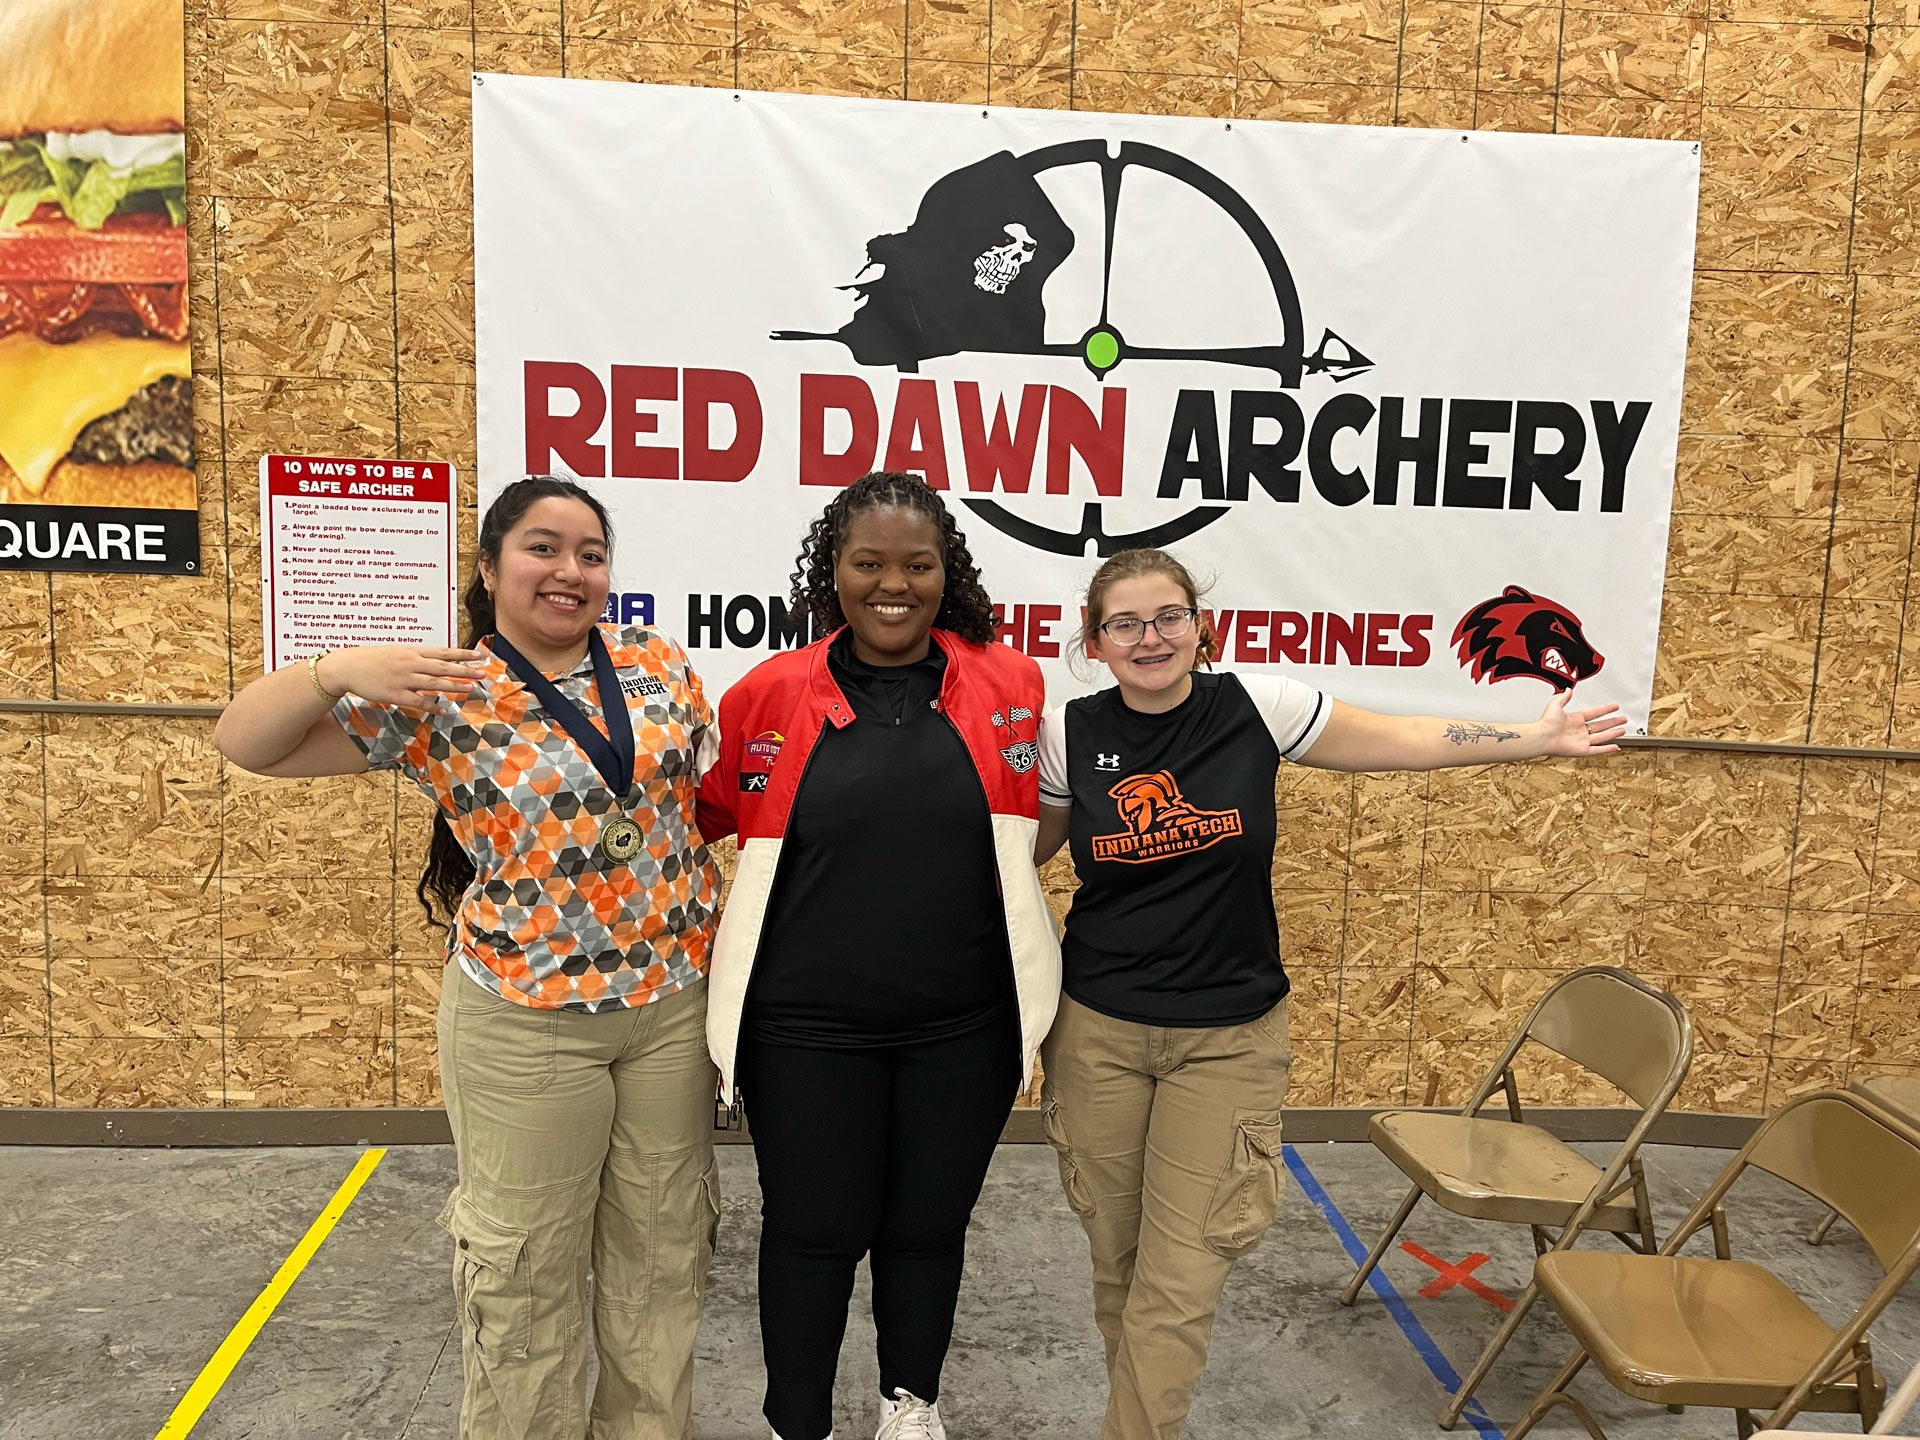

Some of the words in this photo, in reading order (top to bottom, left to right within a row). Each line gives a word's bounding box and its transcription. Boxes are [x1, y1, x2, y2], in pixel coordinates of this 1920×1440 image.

[524, 361, 763, 482] RED
[800, 373, 1127, 497] DAWN
[1156, 388, 1653, 513] ARCHERY
[284, 461, 302, 473] 10
[309, 462, 356, 476] WAYS
[363, 465, 385, 477] TO
[392, 466, 415, 479] BE
[422, 467, 433, 480] A
[299, 480, 341, 494] SAFE
[348, 482, 414, 497] ARCHER
[292, 509, 318, 517] target.
[372, 506, 414, 514] exclusively
[292, 524, 320, 532] Always
[323, 525, 342, 533] point
[379, 527, 423, 535] downrange
[391, 573, 418, 581] whistle
[688, 594, 812, 650] HOM
[991, 603, 1062, 658] HE
[620, 675, 661, 689] INDIANA
[624, 683, 668, 699] TECH
[1013, 751, 1030, 768] 66
[1097, 827, 1183, 857] INDIANA
[1183, 815, 1237, 838] TECH
[1138, 839, 1199, 858] WARRIORS
